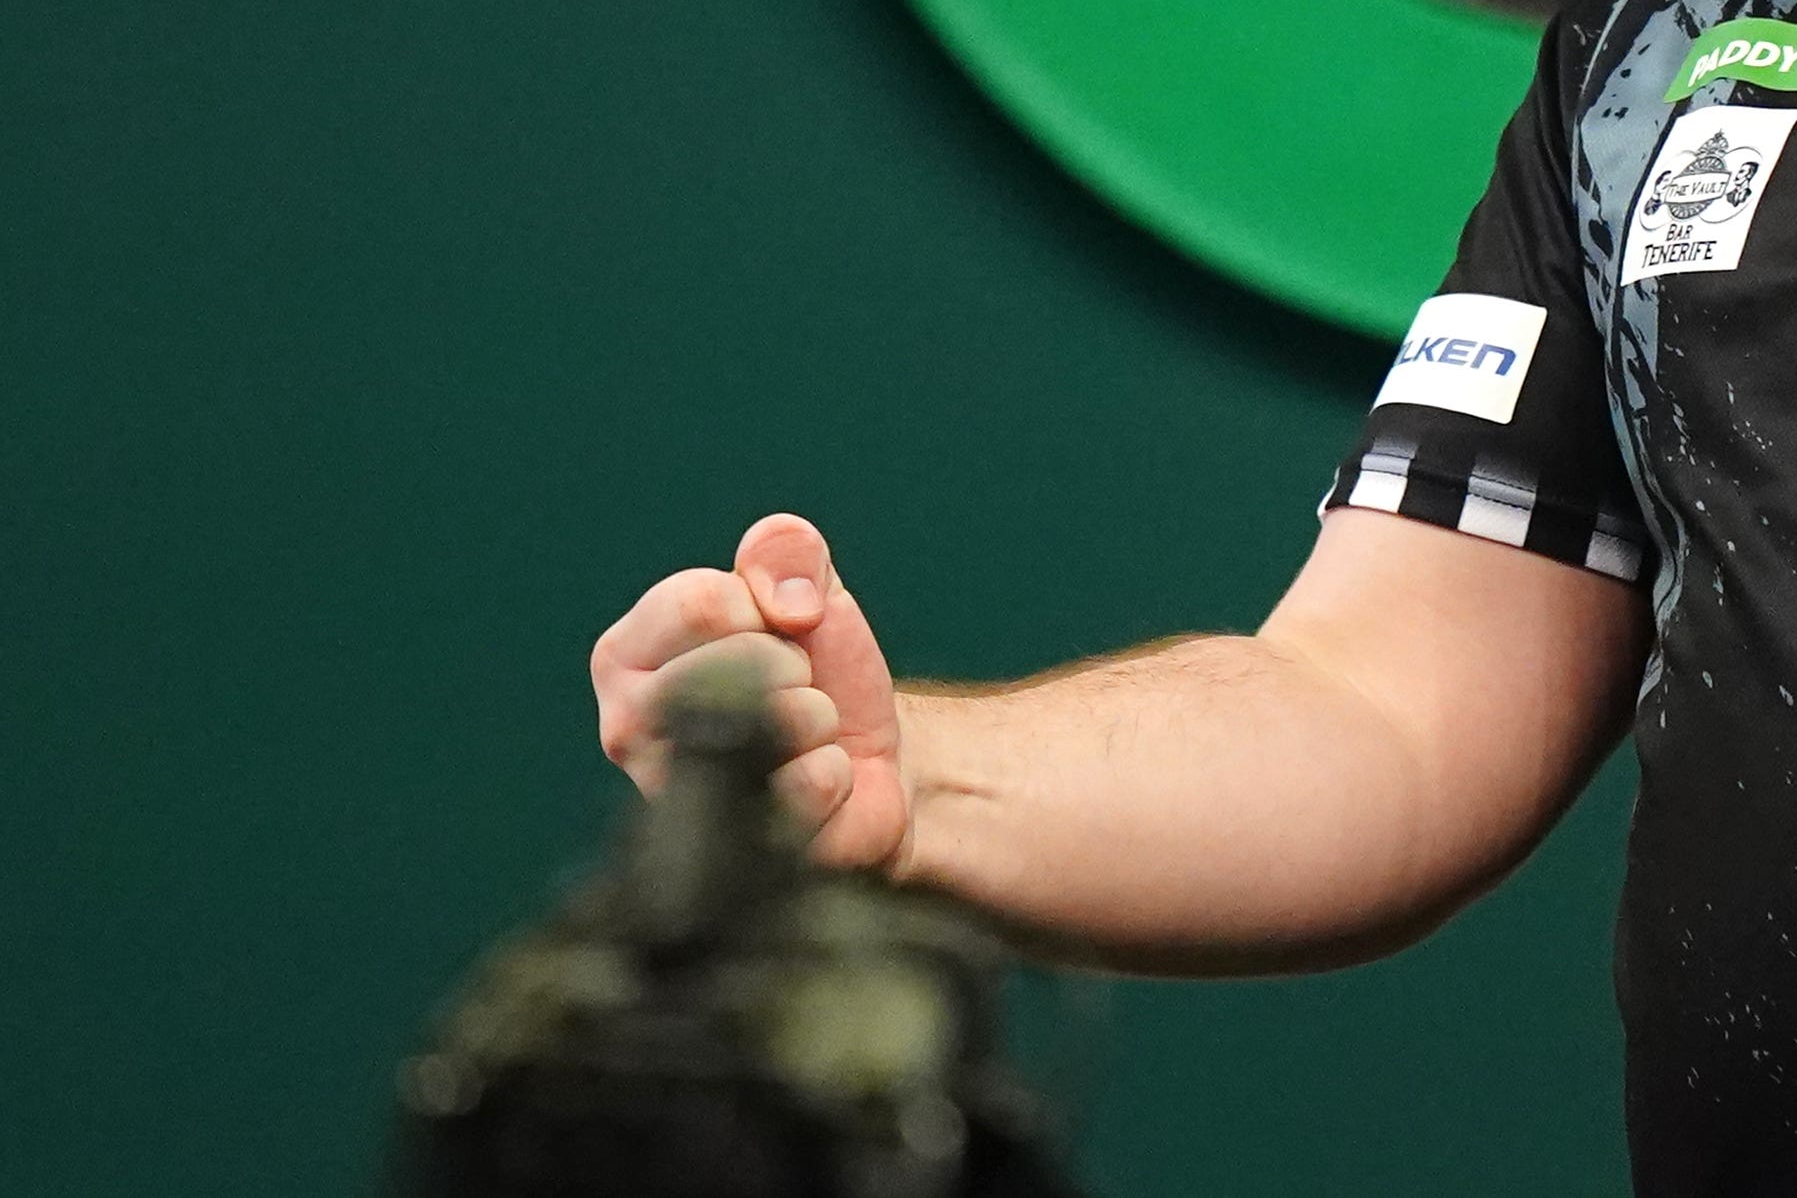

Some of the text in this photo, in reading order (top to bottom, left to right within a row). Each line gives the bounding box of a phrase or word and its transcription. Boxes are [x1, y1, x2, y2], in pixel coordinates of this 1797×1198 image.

[1662, 180, 1727, 197] THE VAULT
[1665, 222, 1694, 242] BAR
[1641, 239, 1718, 269] TENERIFE
